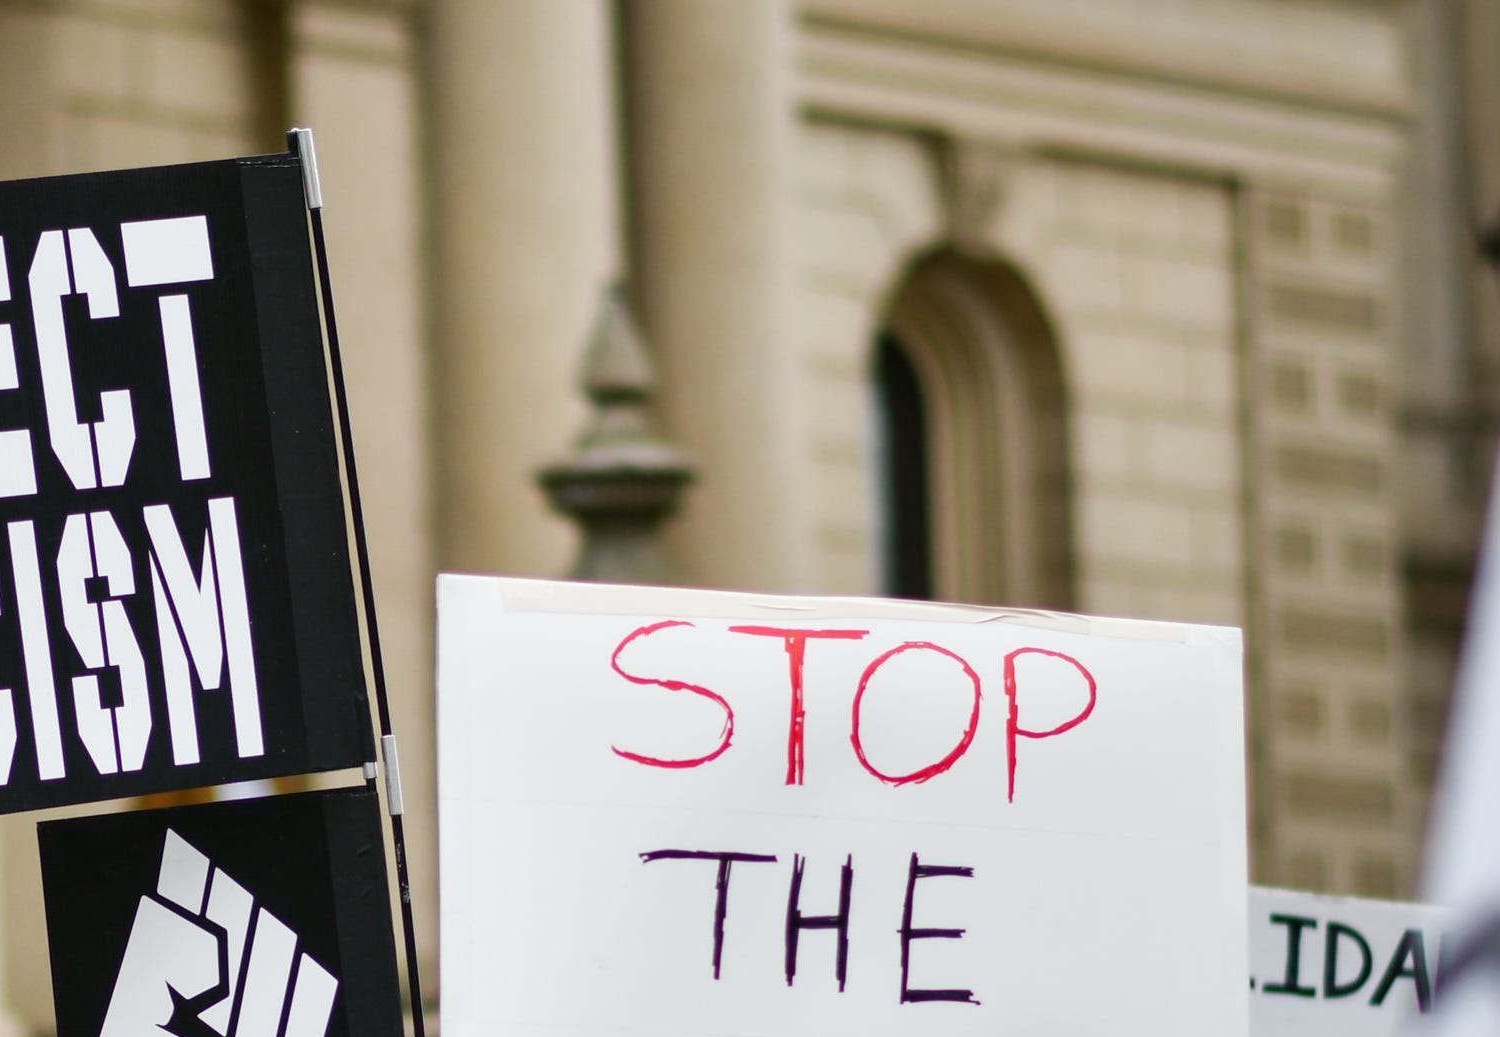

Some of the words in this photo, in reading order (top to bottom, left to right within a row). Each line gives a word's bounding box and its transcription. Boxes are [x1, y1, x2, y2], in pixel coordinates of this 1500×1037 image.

[611, 620, 1097, 803] STOP
[638, 852, 981, 1005] THE
[1250, 913, 1452, 1015] IDA
